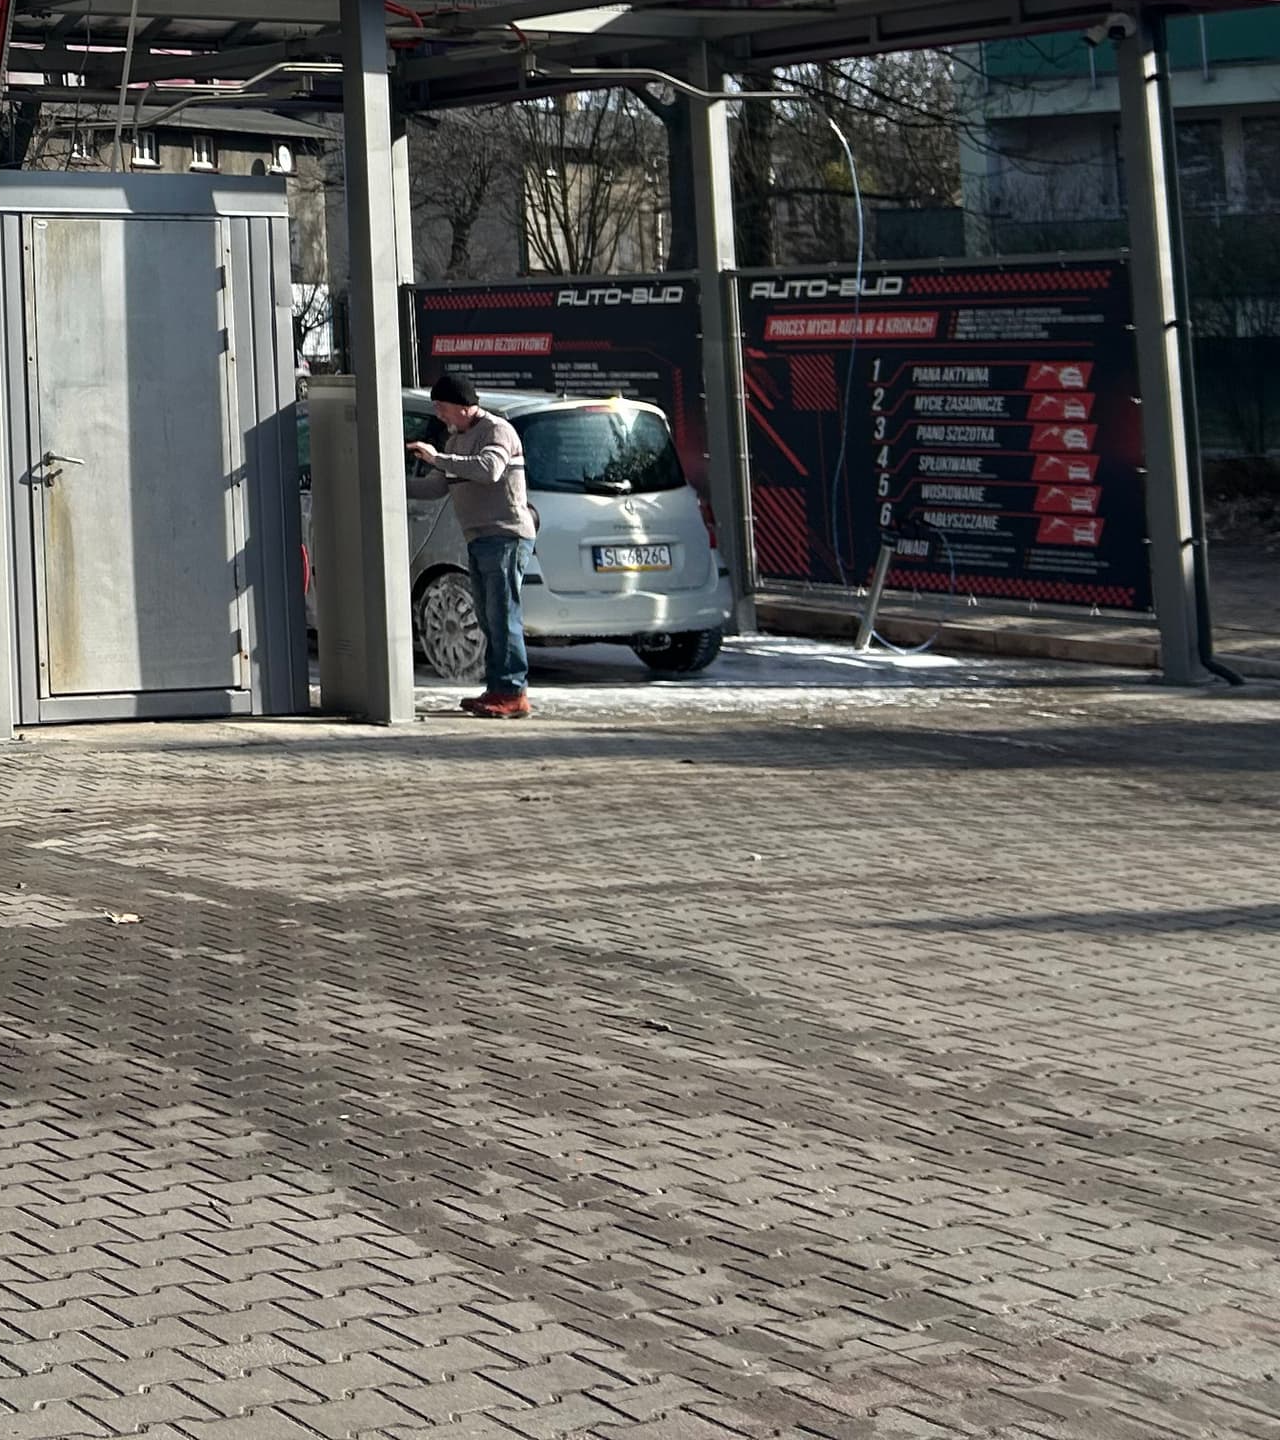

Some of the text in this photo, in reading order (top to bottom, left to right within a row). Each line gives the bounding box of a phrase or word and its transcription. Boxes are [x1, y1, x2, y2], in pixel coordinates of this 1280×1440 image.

[557, 286, 684, 306] AUTO-BUD
[750, 276, 903, 300] AUTO-BUD
[770, 319, 805, 336] PROCES
[806, 318, 836, 335] MYCIA
[838, 318, 862, 334] AUTA
[865, 317, 875, 334] W
[876, 317, 883, 334] 4
[885, 316, 934, 334] KROKACH
[873, 358, 881, 382] 1
[912, 366, 989, 382] PIANA AKTYWNA
[872, 388, 884, 411] 2
[874, 416, 886, 440] 3
[877, 446, 888, 469] 4
[878, 474, 889, 497] 5
[921, 484, 985, 502] WOSKOWANIE
[880, 503, 892, 526] 6
